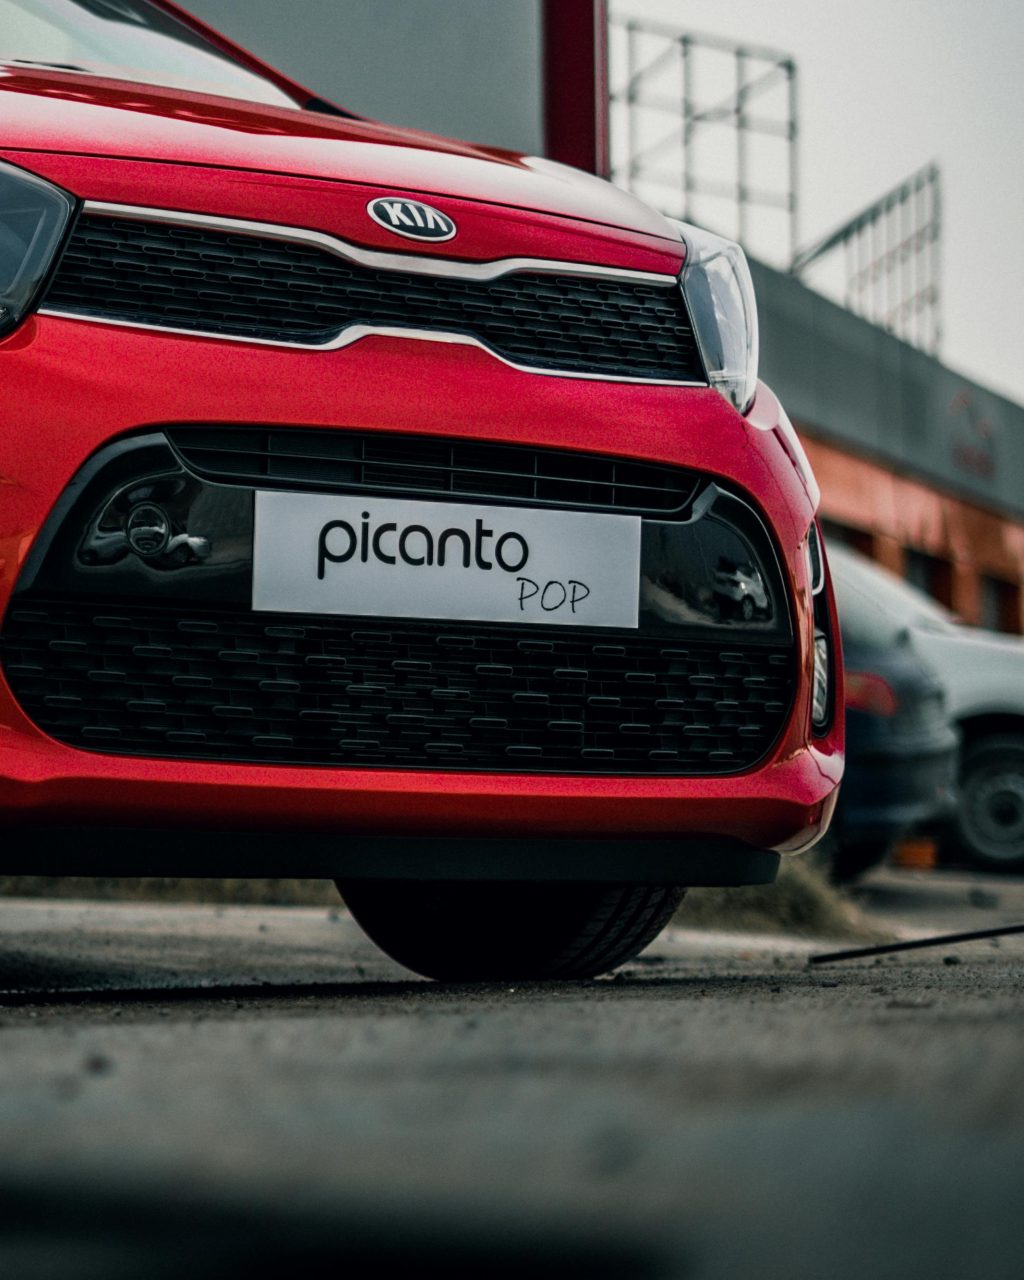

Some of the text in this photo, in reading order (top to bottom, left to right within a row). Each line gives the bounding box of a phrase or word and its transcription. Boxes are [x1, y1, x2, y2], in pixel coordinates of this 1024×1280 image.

[379, 202, 448, 232] KIA
[317, 511, 529, 580] picanto
[516, 577, 590, 613] POP
